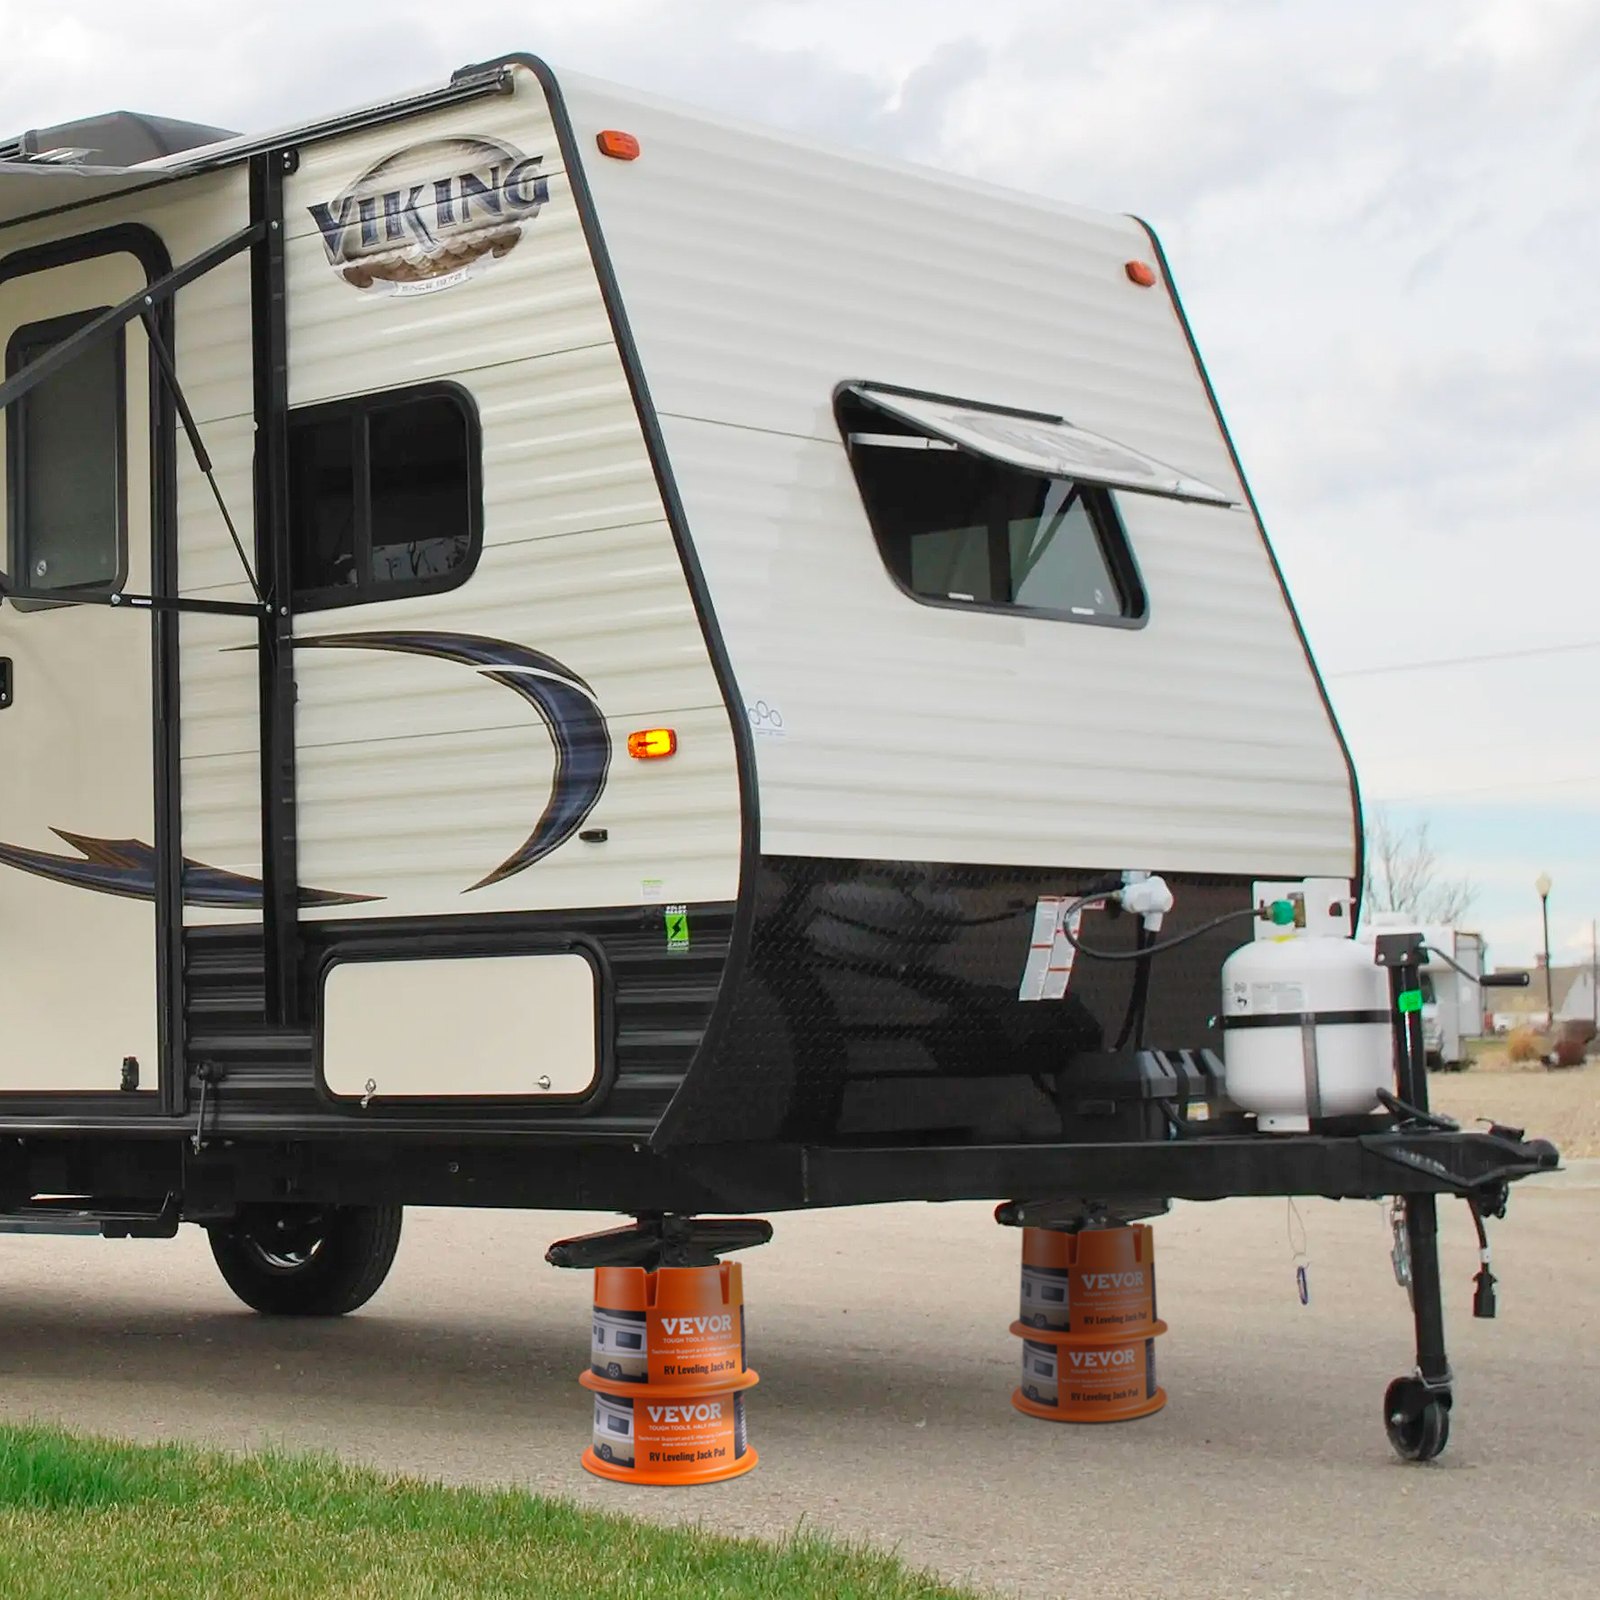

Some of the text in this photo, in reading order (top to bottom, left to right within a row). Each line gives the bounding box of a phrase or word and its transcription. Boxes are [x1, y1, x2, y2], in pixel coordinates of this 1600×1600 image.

[307, 156, 550, 265] VIKING
[1081, 1271, 1144, 1290] VEVOR
[660, 1314, 732, 1335] VEVOR
[1068, 1348, 1136, 1367] VEVOR
[663, 1359, 736, 1376] RV Leveling Jack Pad
[1070, 1391, 1081, 1401] RV
[1082, 1391, 1112, 1402] Leveling
[647, 1402, 722, 1423] VEVOR
[649, 1447, 726, 1463] RV Leveling Jack Pad
